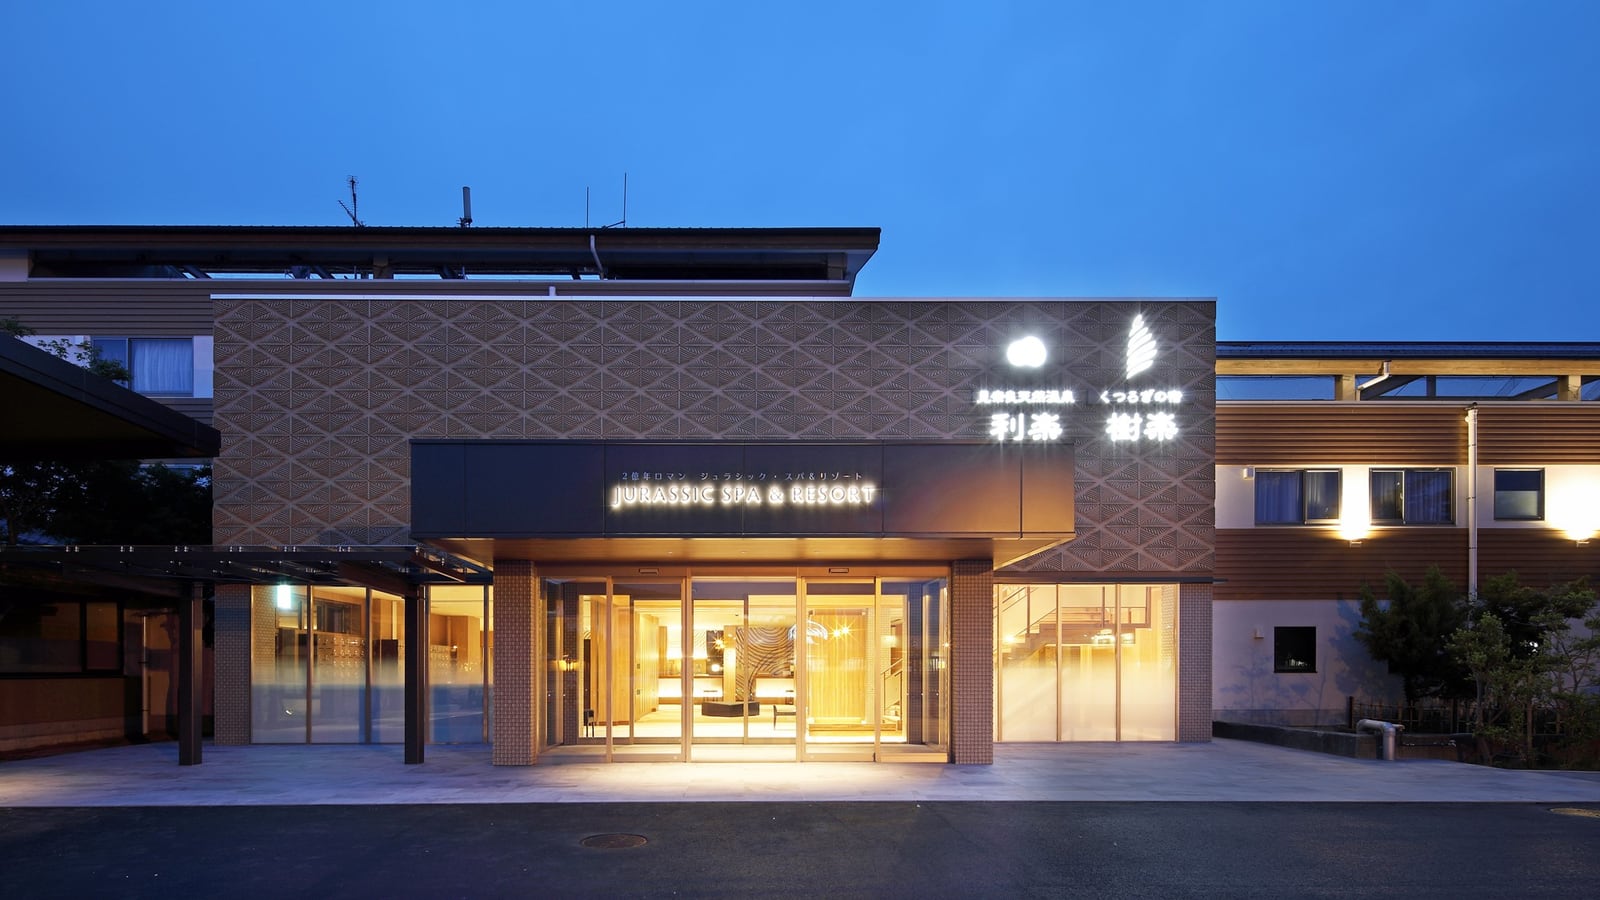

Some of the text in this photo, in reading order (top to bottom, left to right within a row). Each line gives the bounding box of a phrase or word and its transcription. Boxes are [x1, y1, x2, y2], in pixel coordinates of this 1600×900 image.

[989, 412, 1063, 441] 利楽
[611, 485, 876, 508] JURASSIC SPA & RESORT
